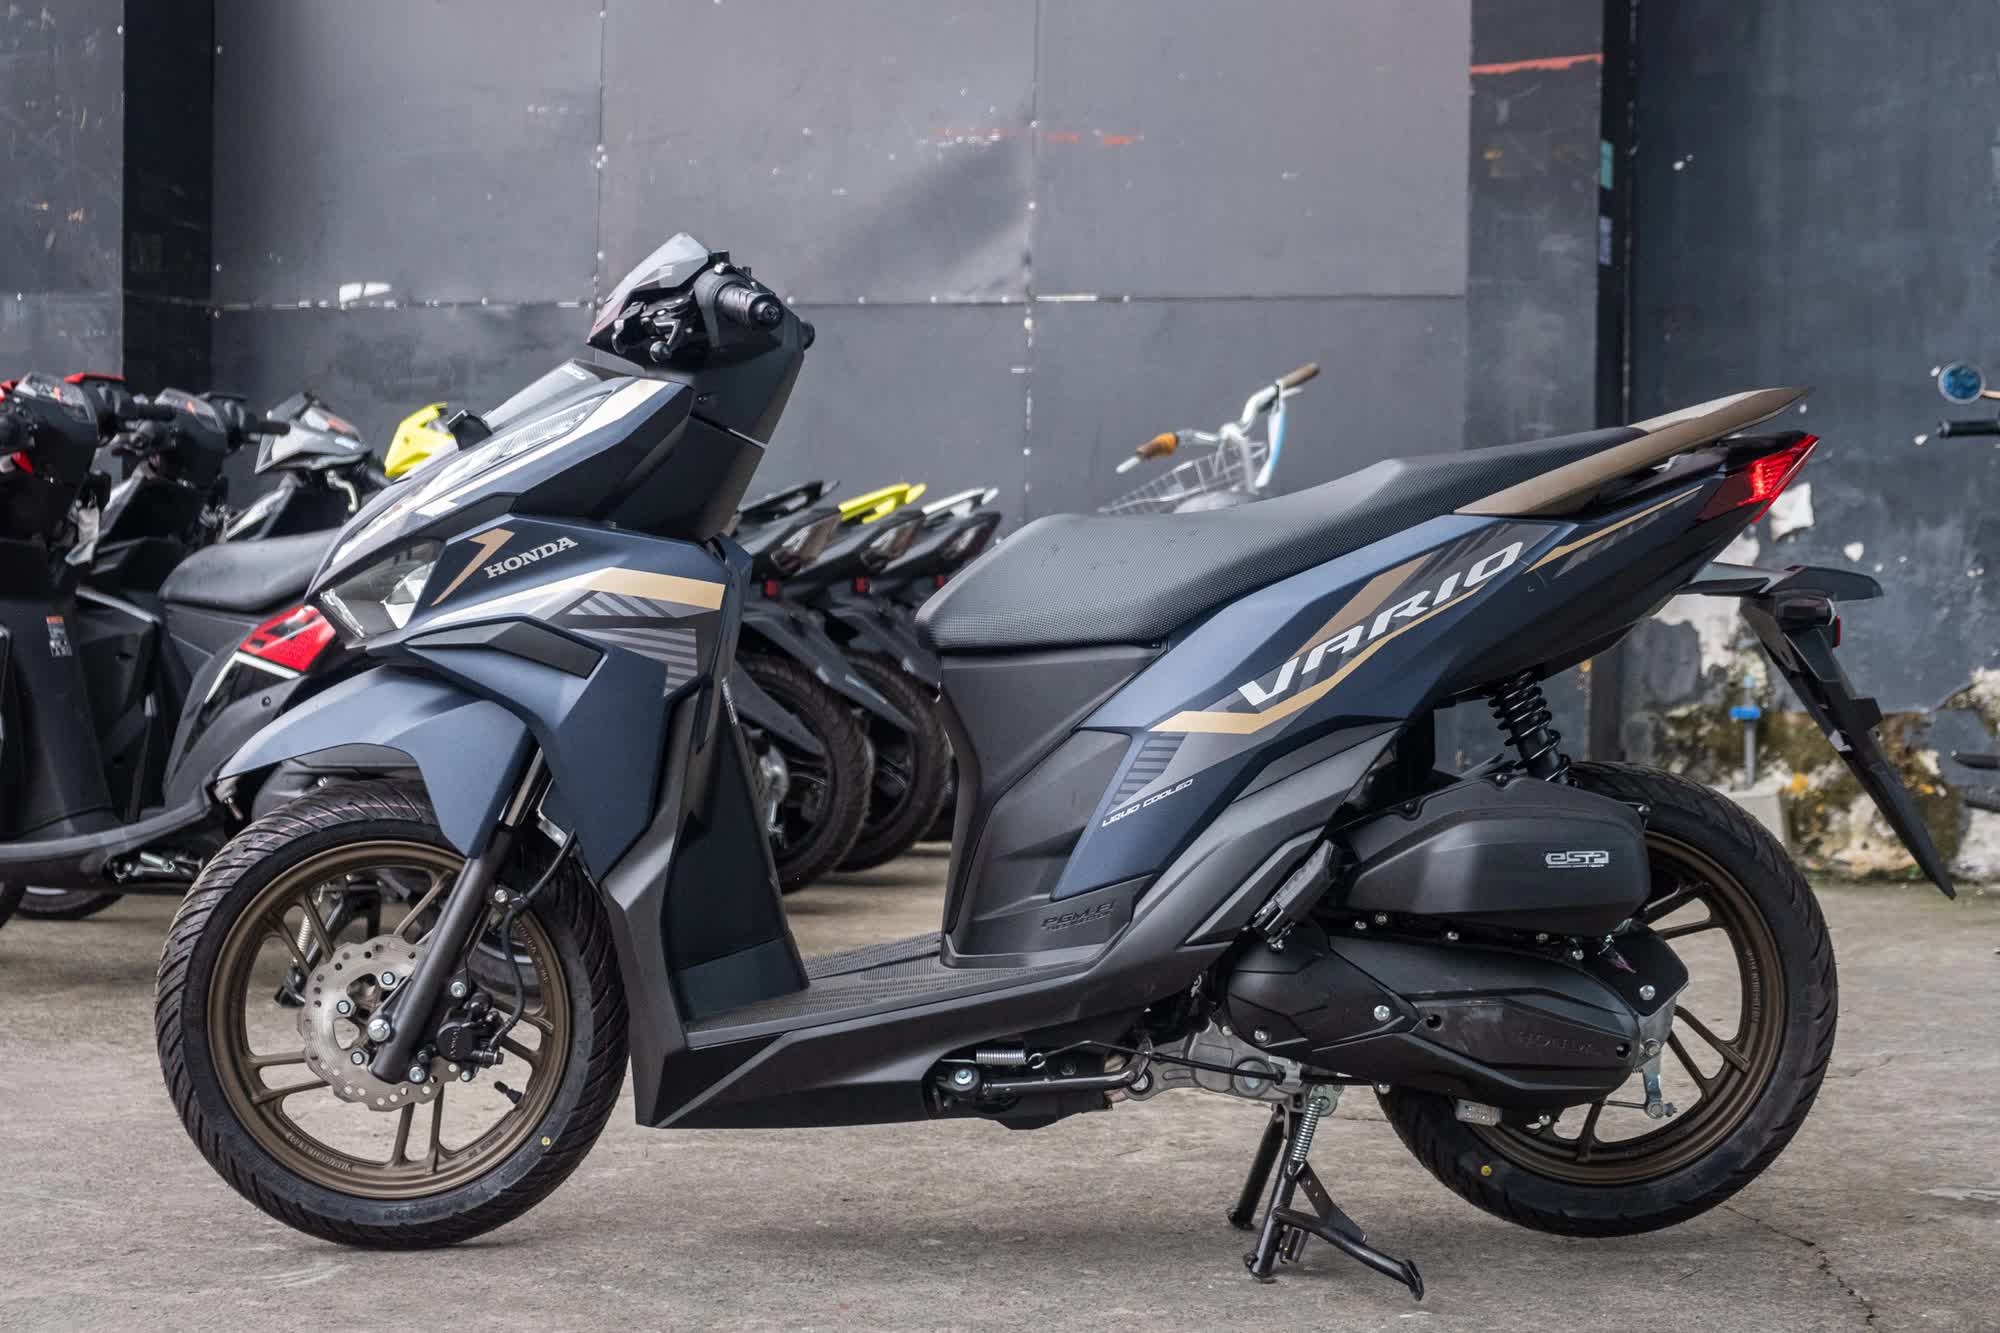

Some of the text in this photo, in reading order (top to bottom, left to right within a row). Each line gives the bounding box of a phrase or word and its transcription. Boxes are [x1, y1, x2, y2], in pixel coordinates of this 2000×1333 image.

[484, 537, 578, 579] HONDA
[1238, 541, 1525, 706] VARIO
[1102, 778, 1193, 827] LIQUID COOLED
